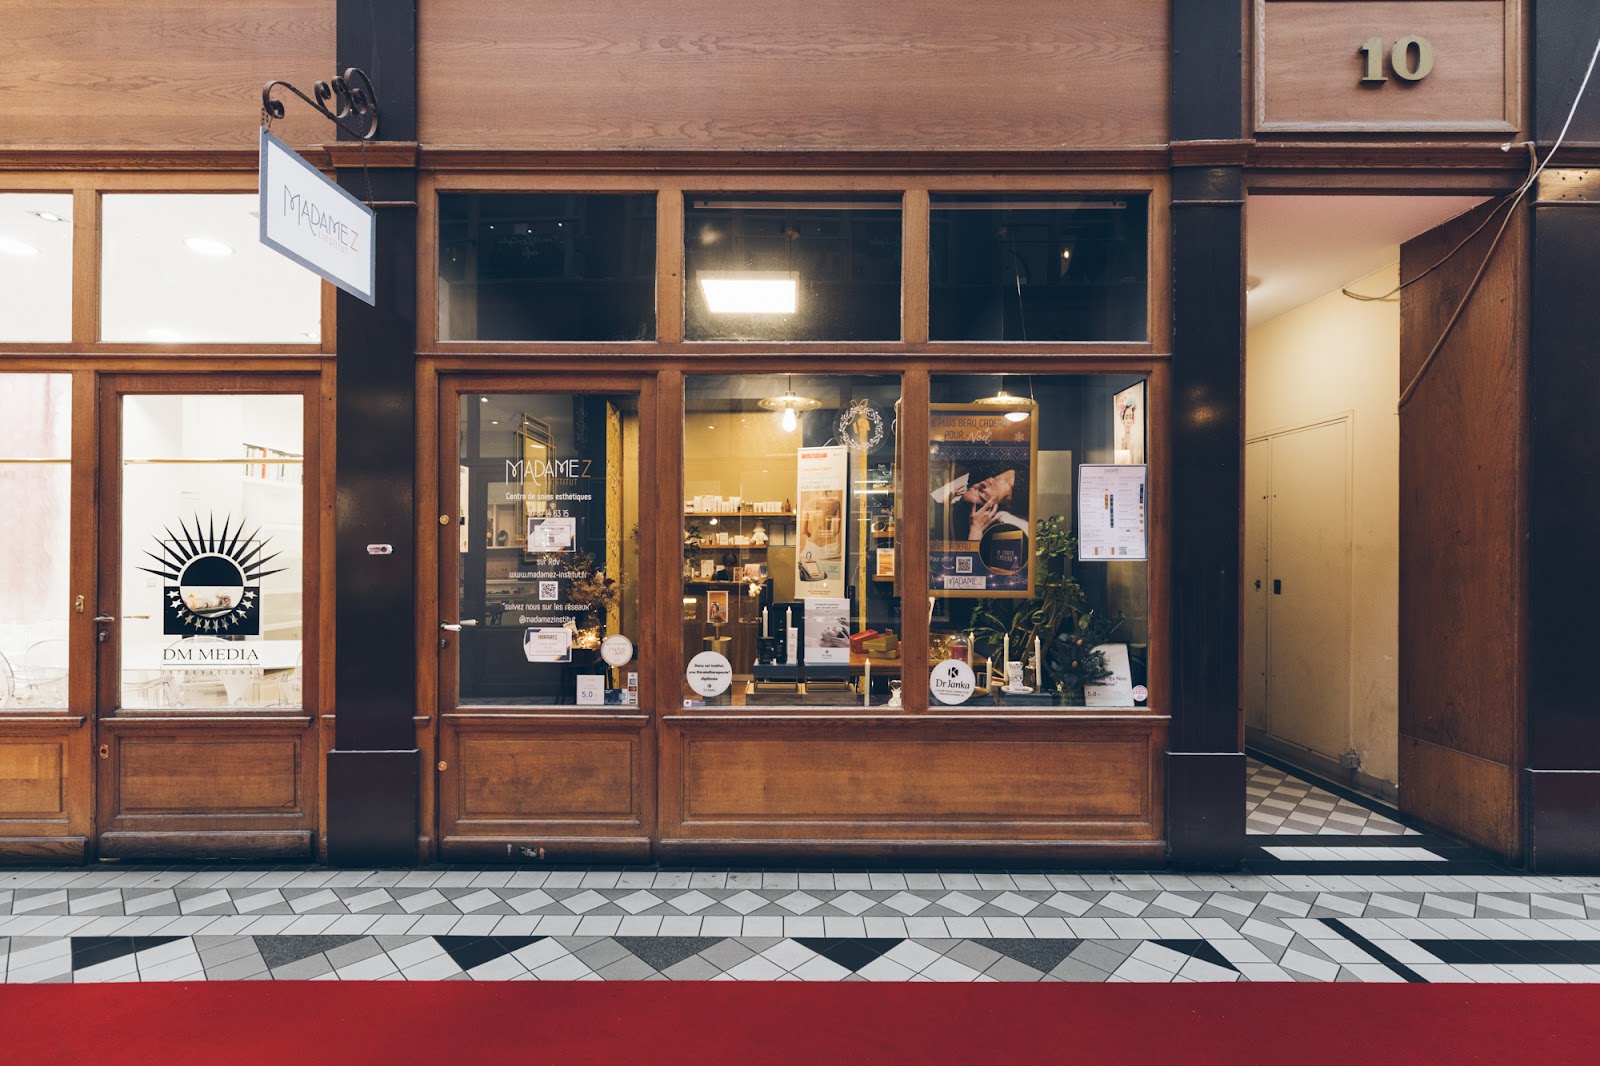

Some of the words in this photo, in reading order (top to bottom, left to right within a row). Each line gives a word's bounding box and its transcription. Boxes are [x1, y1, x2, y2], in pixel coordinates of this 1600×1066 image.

[1360, 35, 1434, 81] 10
[938, 418, 957, 427] PLUS
[958, 418, 977, 427] BEAU
[978, 418, 1007, 427] CADEAU
[944, 430, 964, 440] POUR
[505, 491, 527, 501] Centre
[527, 492, 536, 501] de
[537, 492, 554, 501] soins
[555, 491, 593, 502] esthétiques
[536, 558, 547, 566] sur
[548, 557, 561, 566] Rdv
[525, 603, 541, 611] nous
[541, 603, 553, 611] sur
[553, 602, 564, 611] les
[163, 648, 193, 661] DM
[198, 648, 259, 661] MEDIA
[935, 678, 947, 688] Dr
[947, 679, 970, 690] Janka
